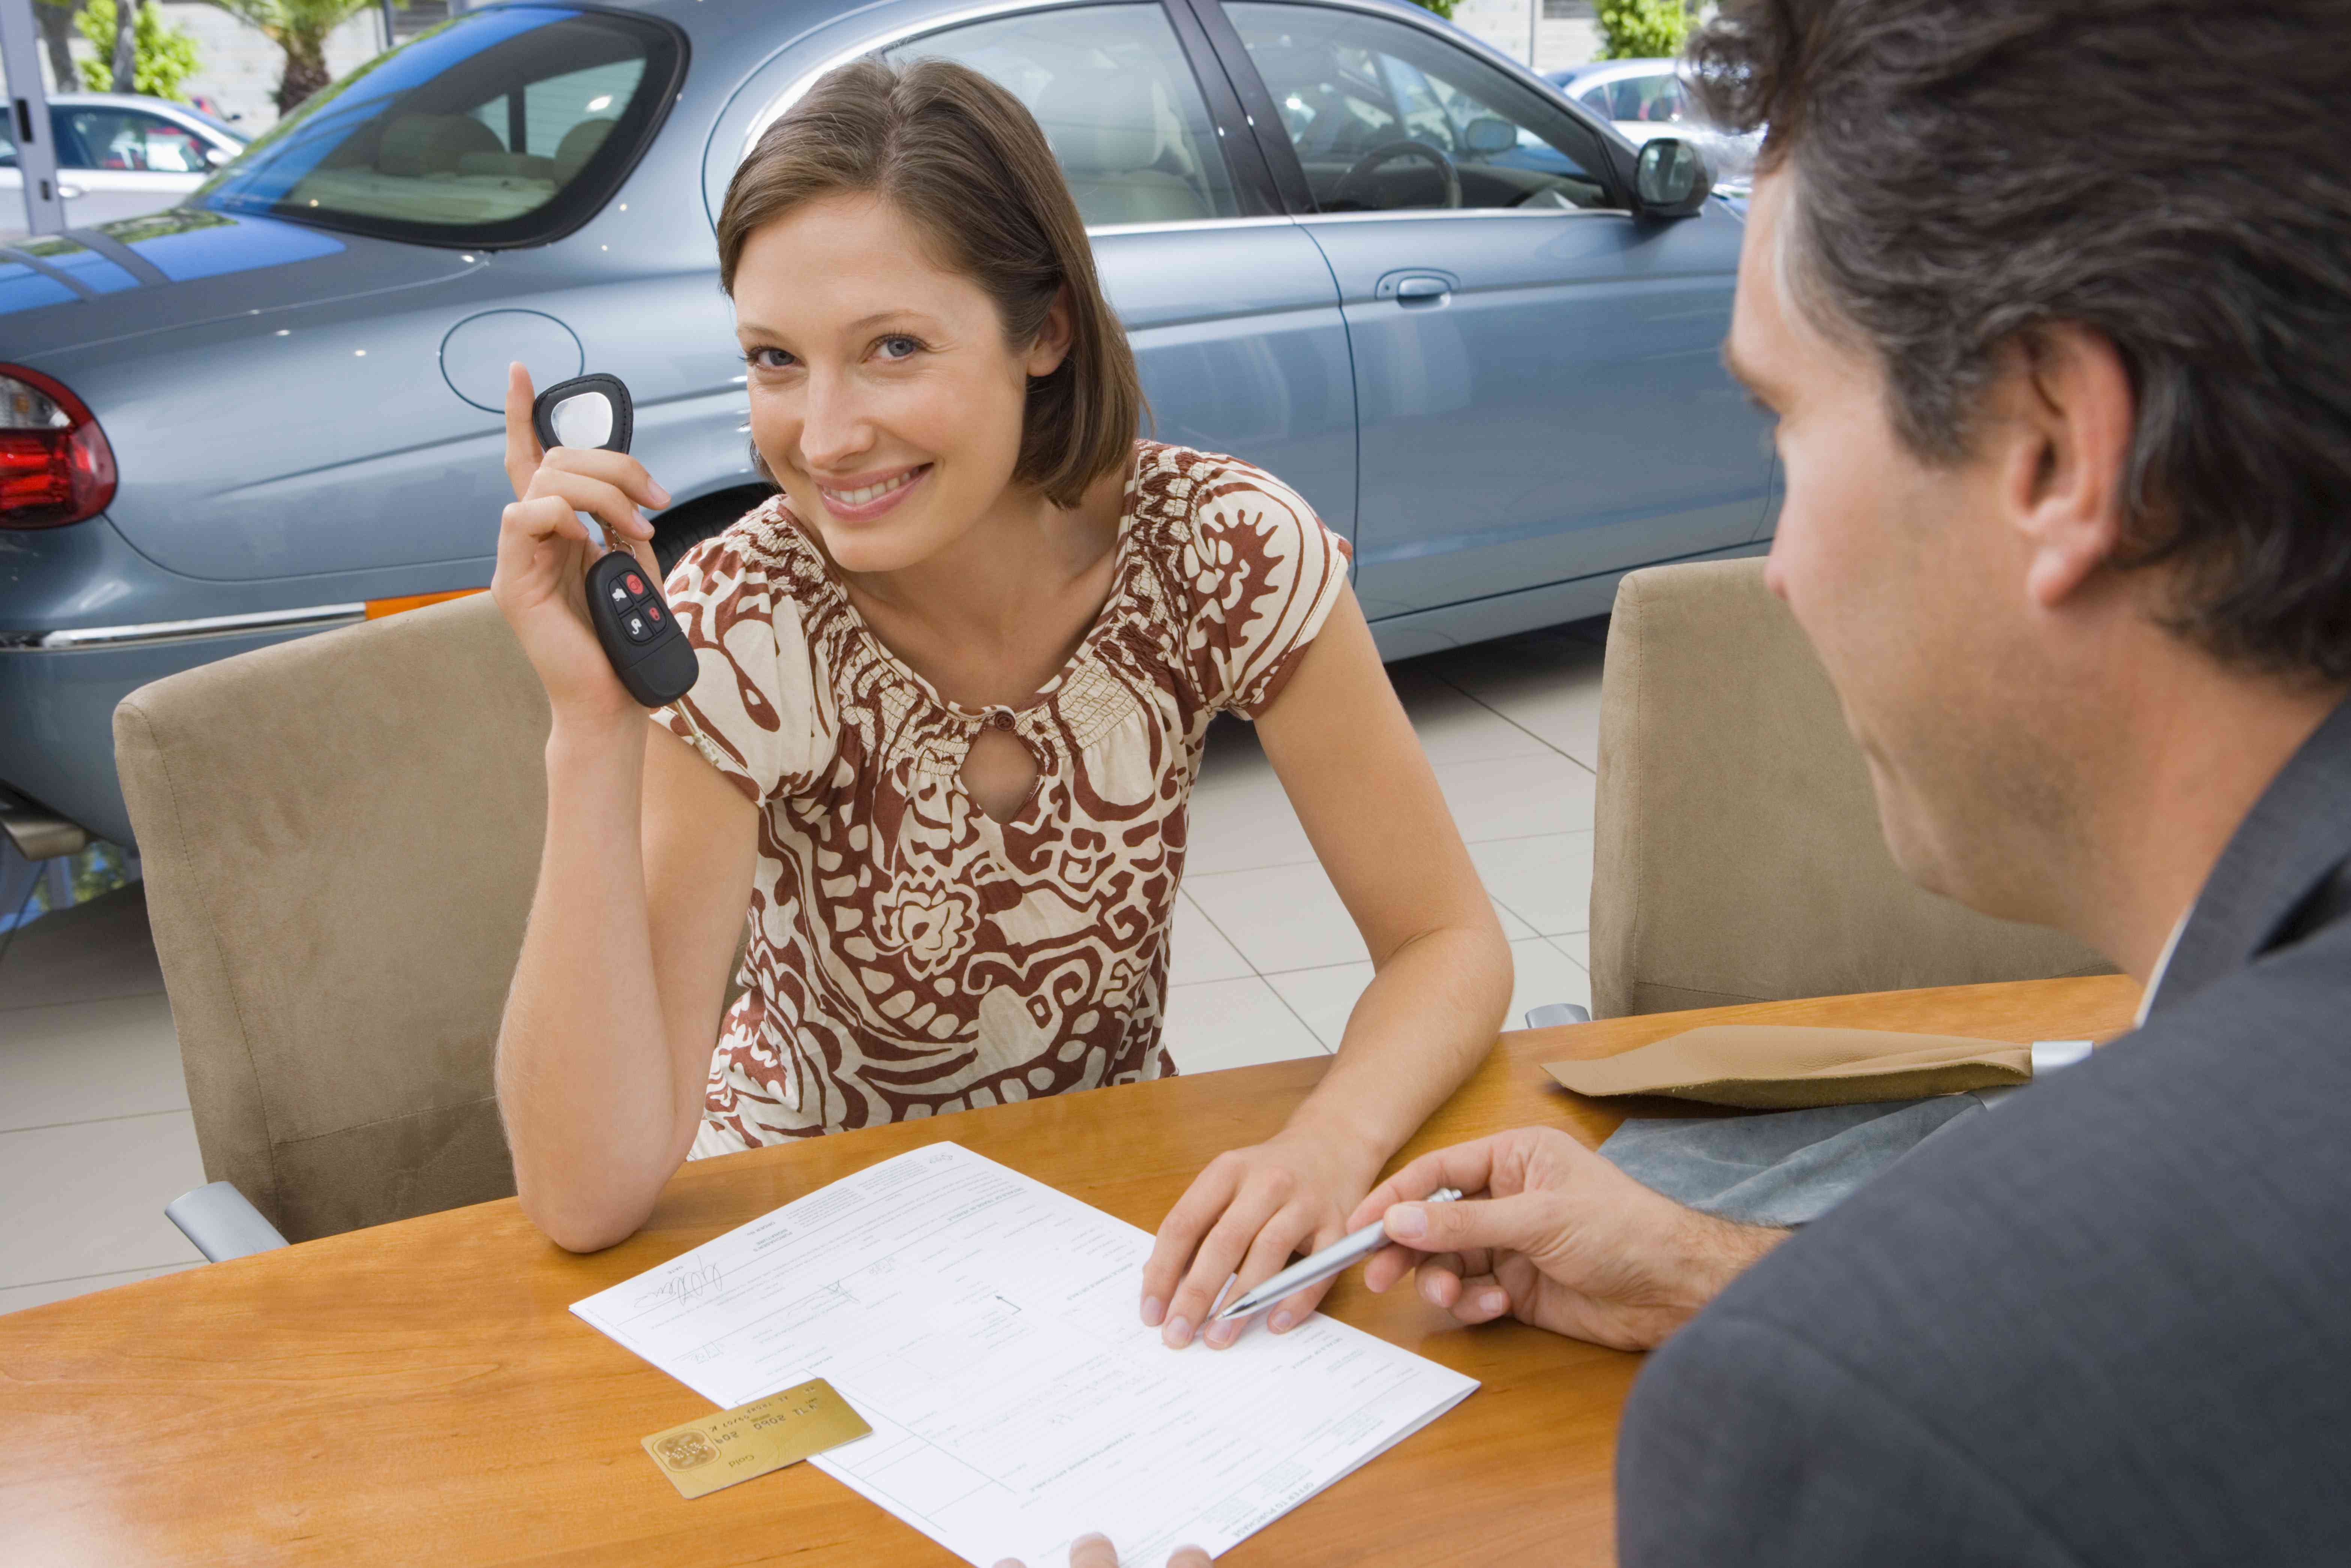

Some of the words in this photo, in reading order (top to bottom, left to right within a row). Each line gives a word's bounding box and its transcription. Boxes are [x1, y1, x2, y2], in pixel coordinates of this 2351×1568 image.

[755, 1229, 788, 1245] SIGNATURE
[727, 1454, 756, 1468] Gold
[1286, 1482, 1316, 1501] OFFER
[1274, 1500, 1289, 1509] TO
[1231, 1508, 1277, 1537] PURCHASE
